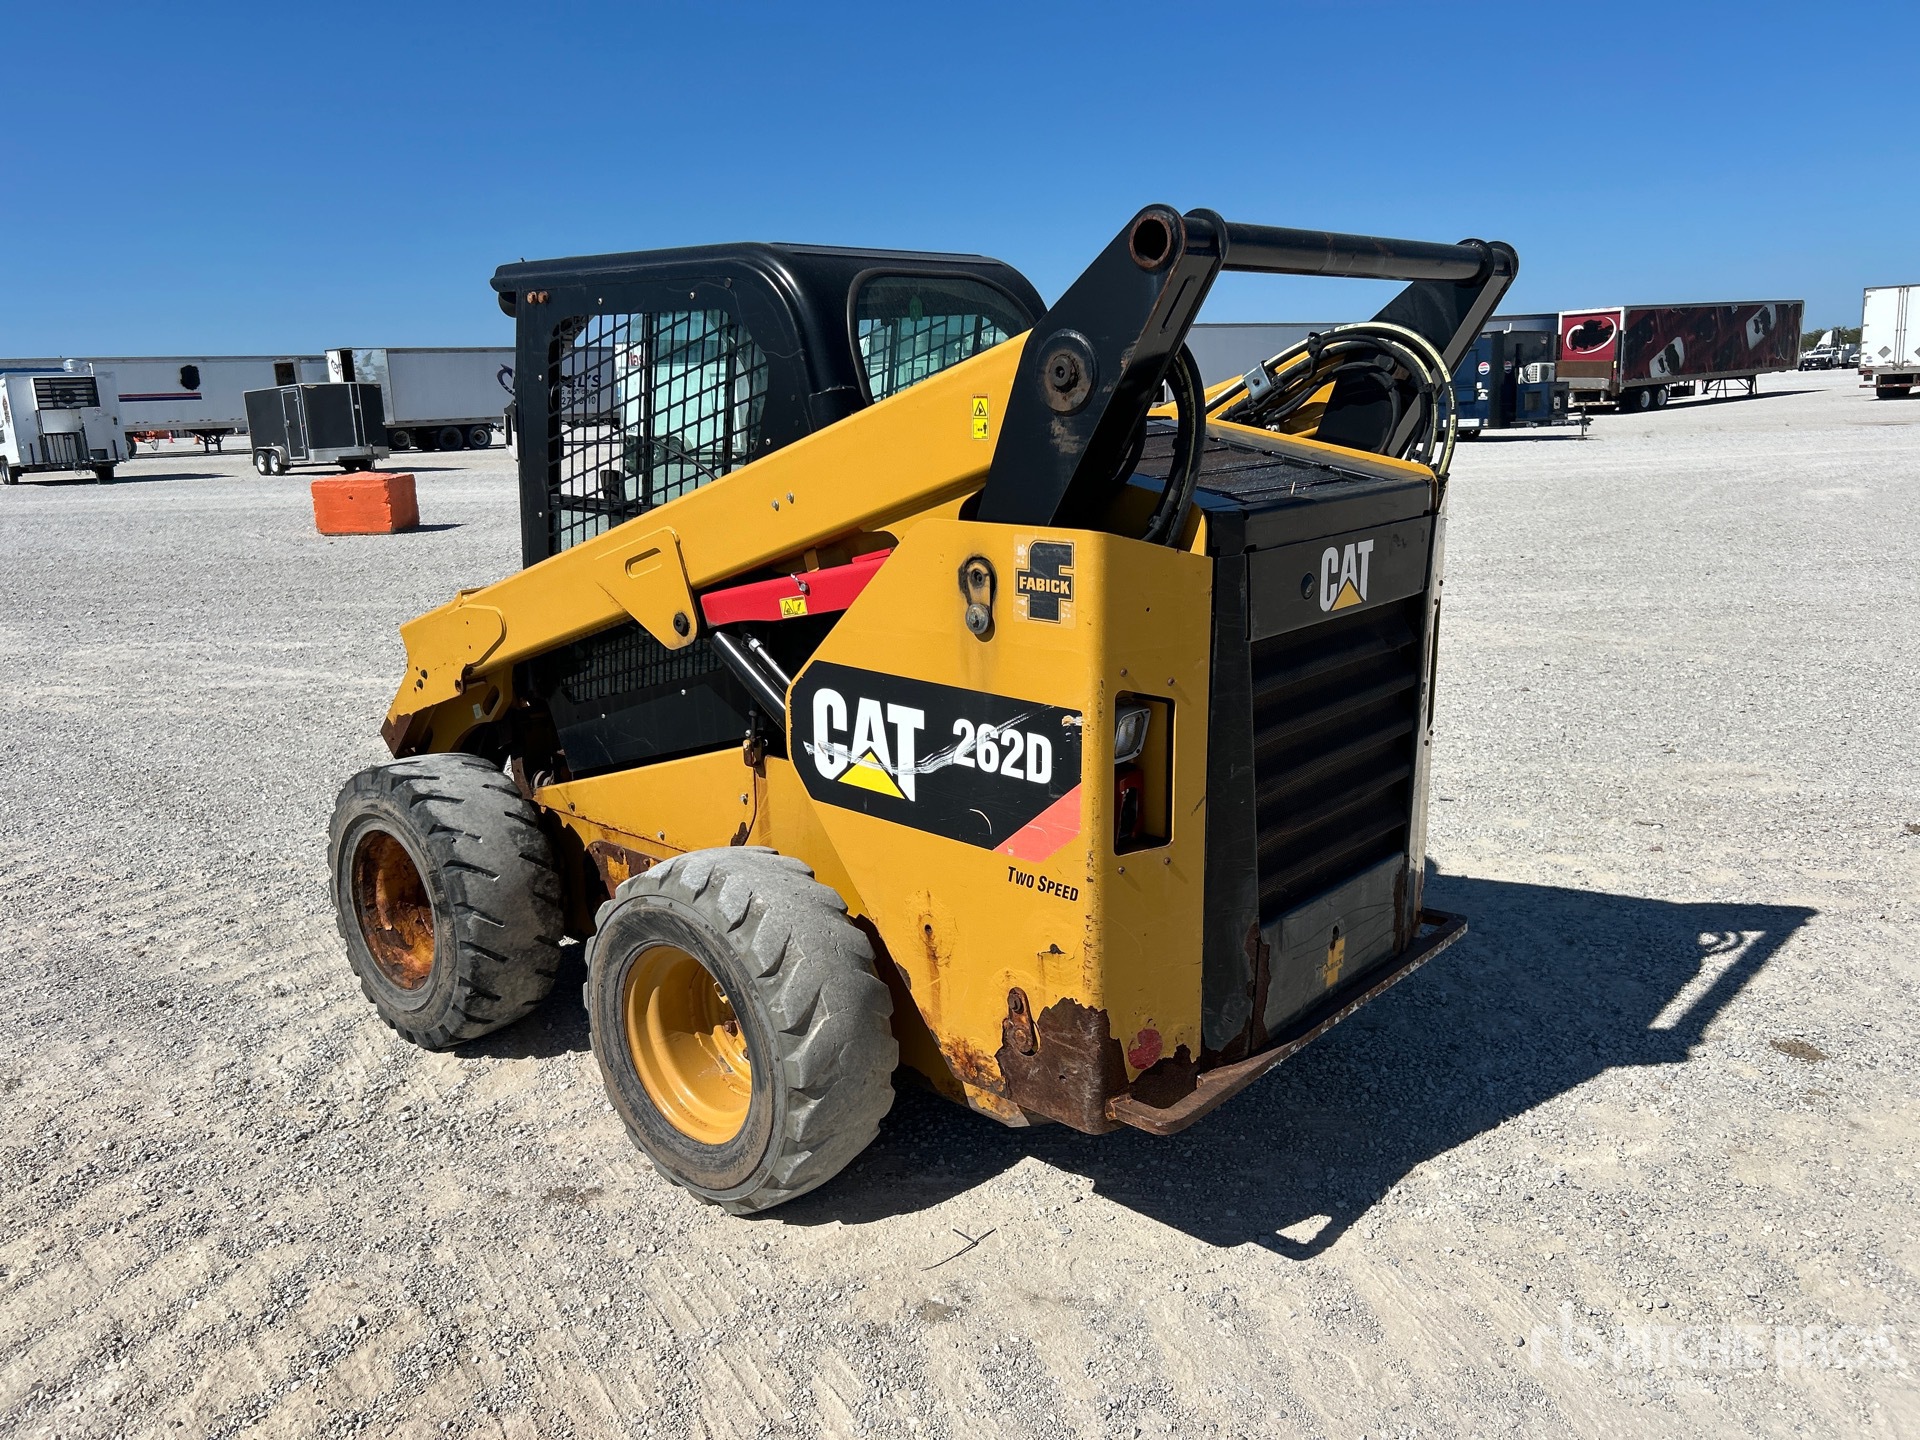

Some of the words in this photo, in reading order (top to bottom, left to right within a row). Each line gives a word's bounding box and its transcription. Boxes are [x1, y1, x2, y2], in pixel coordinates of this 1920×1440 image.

[1019, 576, 1070, 594] FABICK
[1320, 539, 1374, 612] CAT
[813, 688, 924, 802] CAT
[953, 718, 1052, 784] 262D
